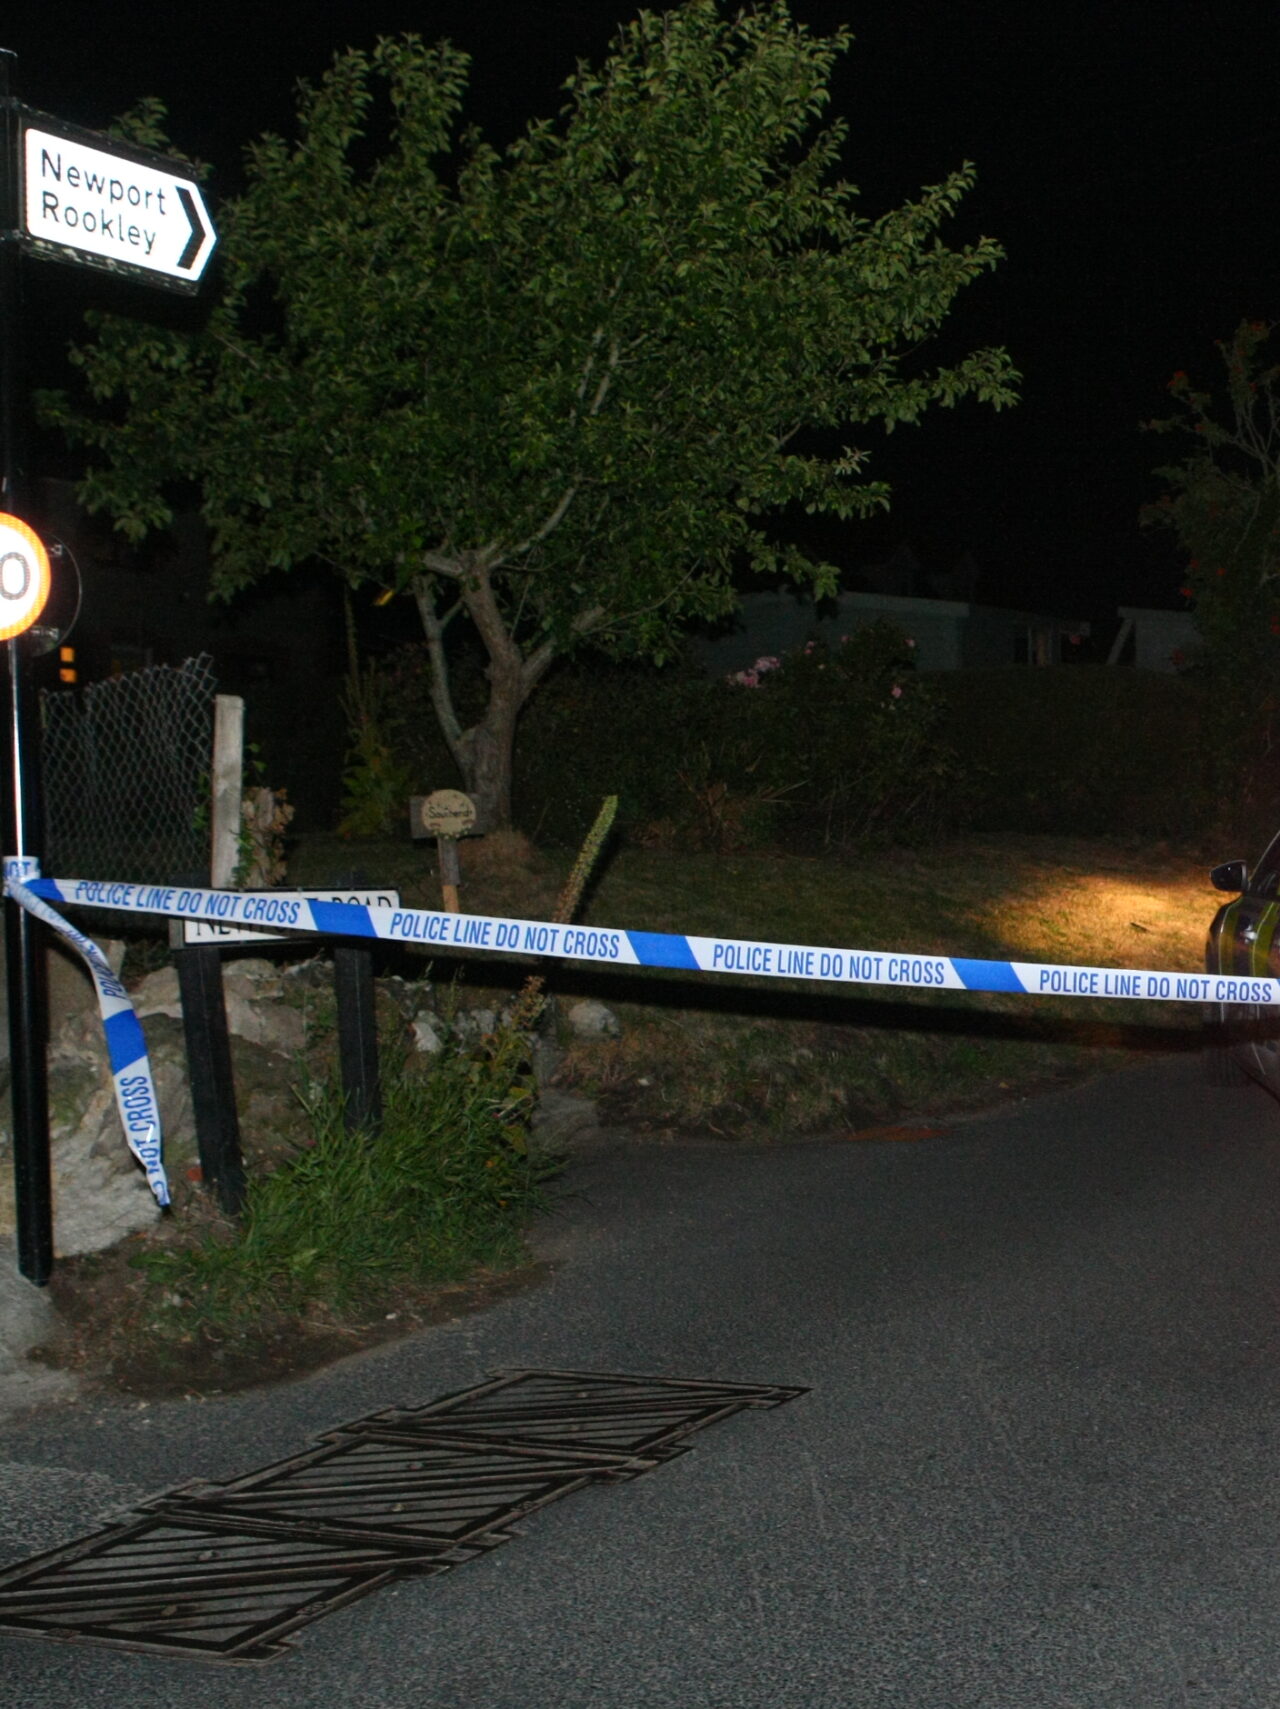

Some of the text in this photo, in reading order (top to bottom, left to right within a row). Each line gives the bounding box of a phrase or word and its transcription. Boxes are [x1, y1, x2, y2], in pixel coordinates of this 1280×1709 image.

[41, 148, 166, 215] Newport
[42, 190, 156, 254] Rookley
[76, 881, 134, 906] POLICE
[136, 887, 176, 910] LINE
[177, 891, 202, 913] DO
[204, 893, 242, 917] NOT
[243, 898, 300, 924] CROSS
[390, 912, 620, 958] POLICE LINE DO NOT CROSS
[712, 944, 945, 985] POLICE LINE DO NOT CROSS
[1039, 969, 1272, 1002] POLICE LINE DO NOT CROSS
[120, 1075, 156, 1133] CROSS
